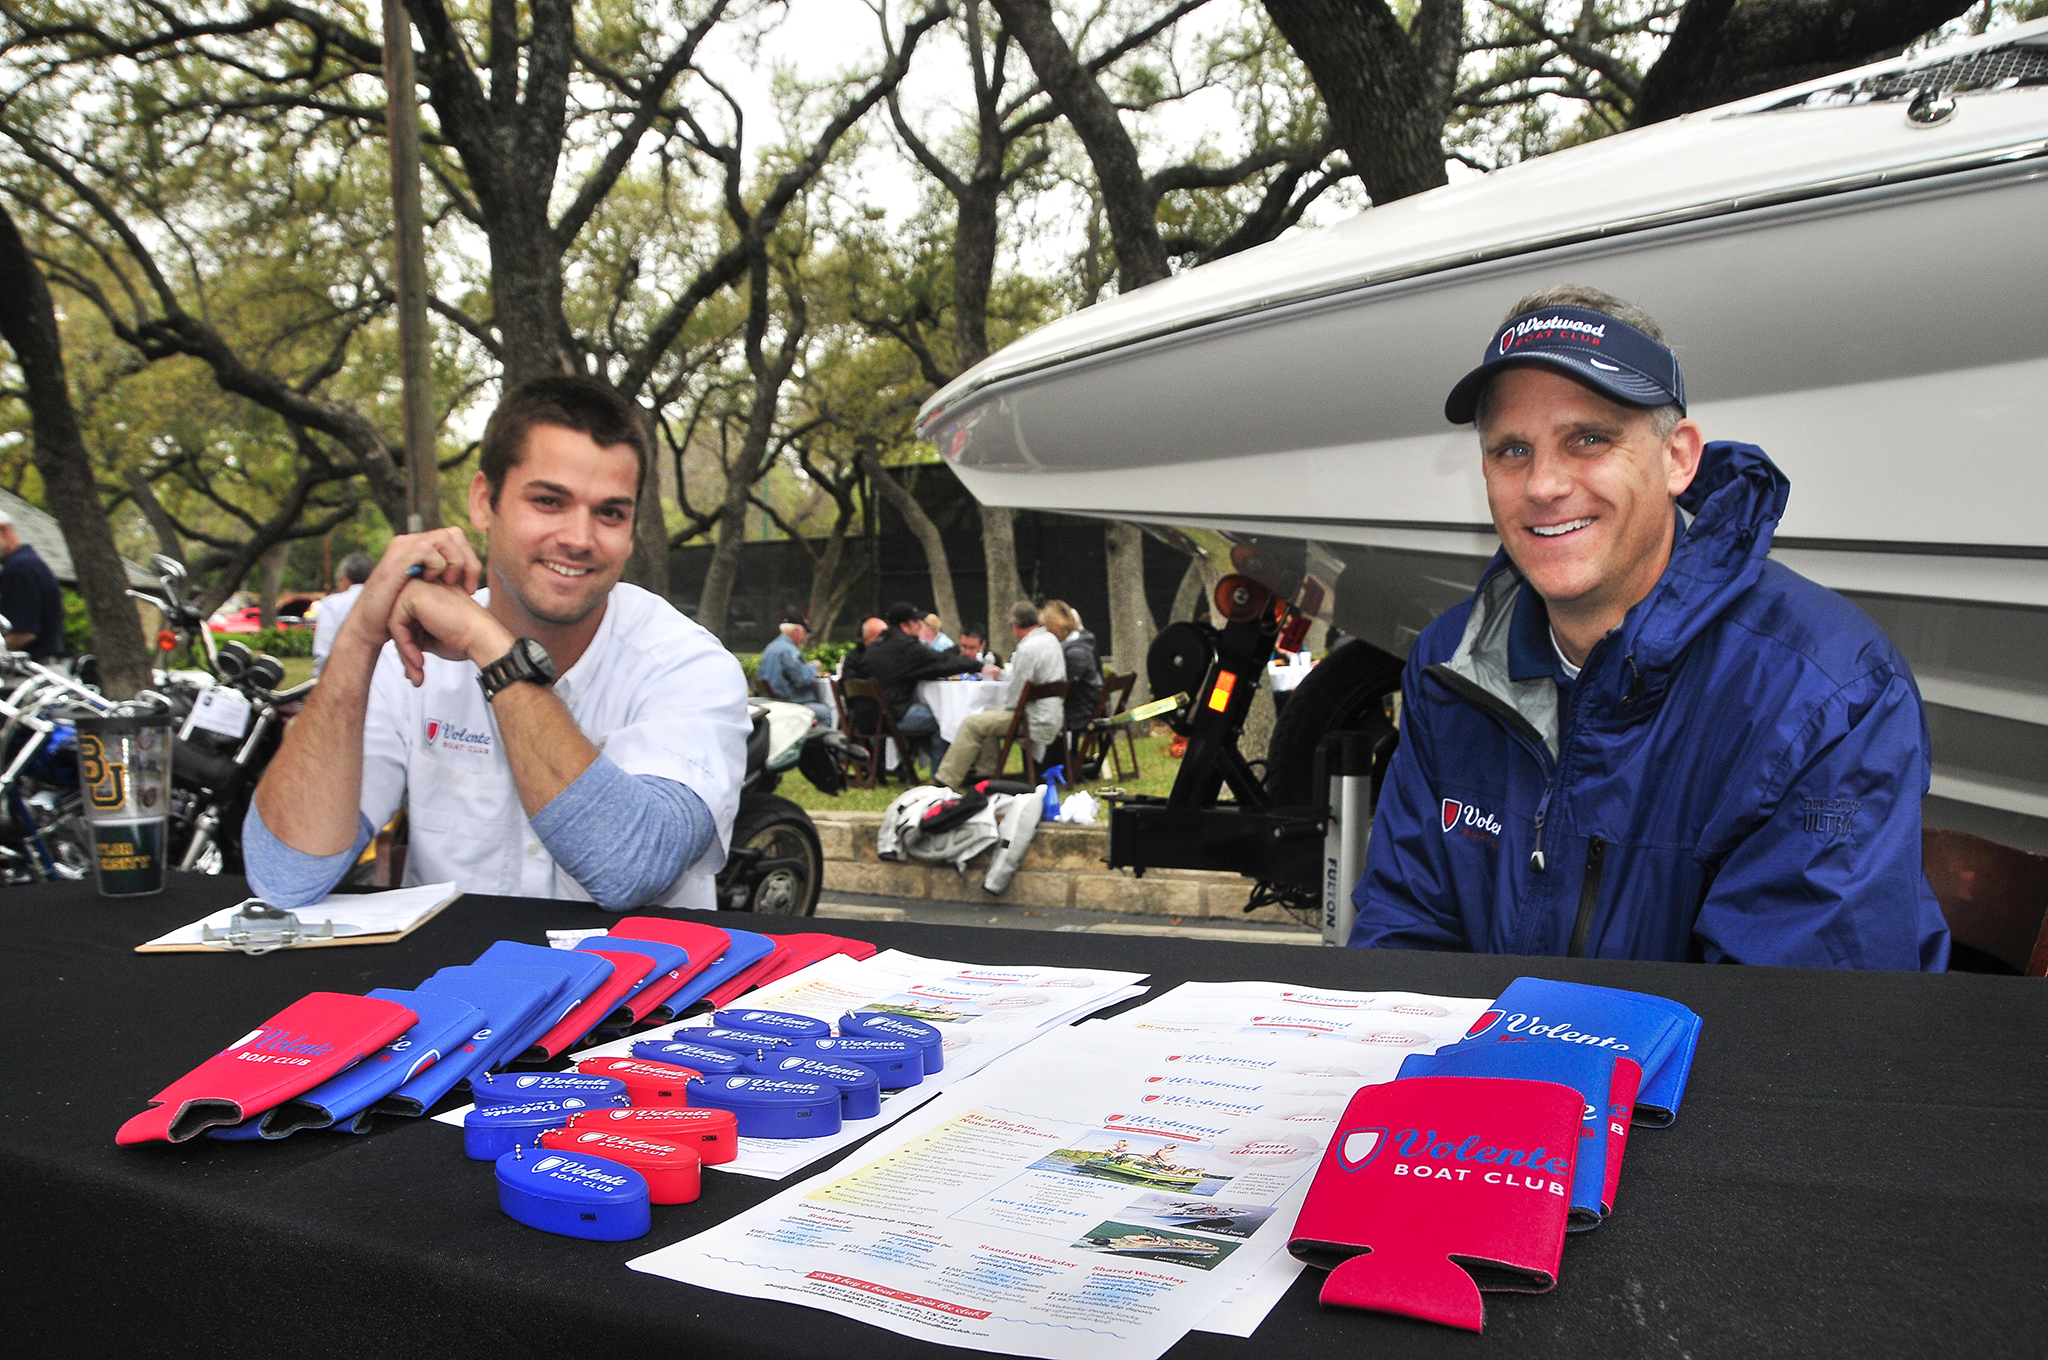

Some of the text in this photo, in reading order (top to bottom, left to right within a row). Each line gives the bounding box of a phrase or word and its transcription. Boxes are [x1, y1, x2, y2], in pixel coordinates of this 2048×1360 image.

[1516, 315, 1605, 337] Westwood
[1515, 330, 1601, 346] BOAT CLUB
[442, 722, 490, 744] Volente
[1327, 857, 1338, 928] FULTON
[764, 1014, 815, 1027] Volente
[883, 1020, 930, 1036] Volente
[875, 1025, 919, 1039] BOAT CLUB
[255, 1026, 335, 1057] Volente
[838, 1039, 906, 1048] Volente
[237, 1051, 311, 1067] BOAT CLUB
[682, 1046, 736, 1062] Volente
[701, 1056, 726, 1064] CLUB
[1187, 1054, 1277, 1067] Westwood
[631, 1062, 689, 1077] Volente
[797, 1068, 857, 1082] BOAT CLUB
[803, 1058, 865, 1077] Volente
[540, 1076, 610, 1086] Volente
[750, 1078, 821, 1091] Volente
[1168, 1077, 1263, 1091] Westwood
[784, 1087, 816, 1095] CLUB
[1166, 1095, 1264, 1111] Westwood
[635, 1108, 712, 1118] Volente
[959, 1118, 992, 1126] None
[1022, 1130, 1060, 1139] hassle.
[1125, 1121, 1166, 1130] BOAT
[1175, 1128, 1216, 1138] CLUB
[1130, 1115, 1231, 1135] Westwood
[603, 1134, 677, 1154] Volente
[701, 1134, 718, 1142] CHINA
[1245, 1141, 1289, 1149] Come
[597, 1141, 667, 1157] BOAT CLUB
[1394, 1129, 1569, 1176] Volente
[559, 1160, 628, 1187] Volente
[1393, 1164, 1565, 1198] BOAT CLUB
[549, 1171, 614, 1194] BOAT CLUB
[1018, 1203, 1055, 1211] AUSTIN
[579, 1212, 598, 1222] CHINA
[808, 1214, 851, 1224] Standard
[846, 1213, 895, 1222] membership
[897, 1221, 932, 1229] category
[906, 1230, 943, 1239] Shared
[979, 1245, 1077, 1268] Standard Weekday
[989, 1254, 1028, 1263] Unlimited
[1091, 1272, 1133, 1280] Unlimited
[1092, 1266, 1186, 1283] Shared Weekday
[812, 1272, 840, 1283] Don't
[840, 1276, 860, 1288] buy
[912, 1295, 937, 1306] Join
[937, 1300, 956, 1311] the
[955, 1305, 987, 1318] club!
[866, 1293, 890, 1304] Street
